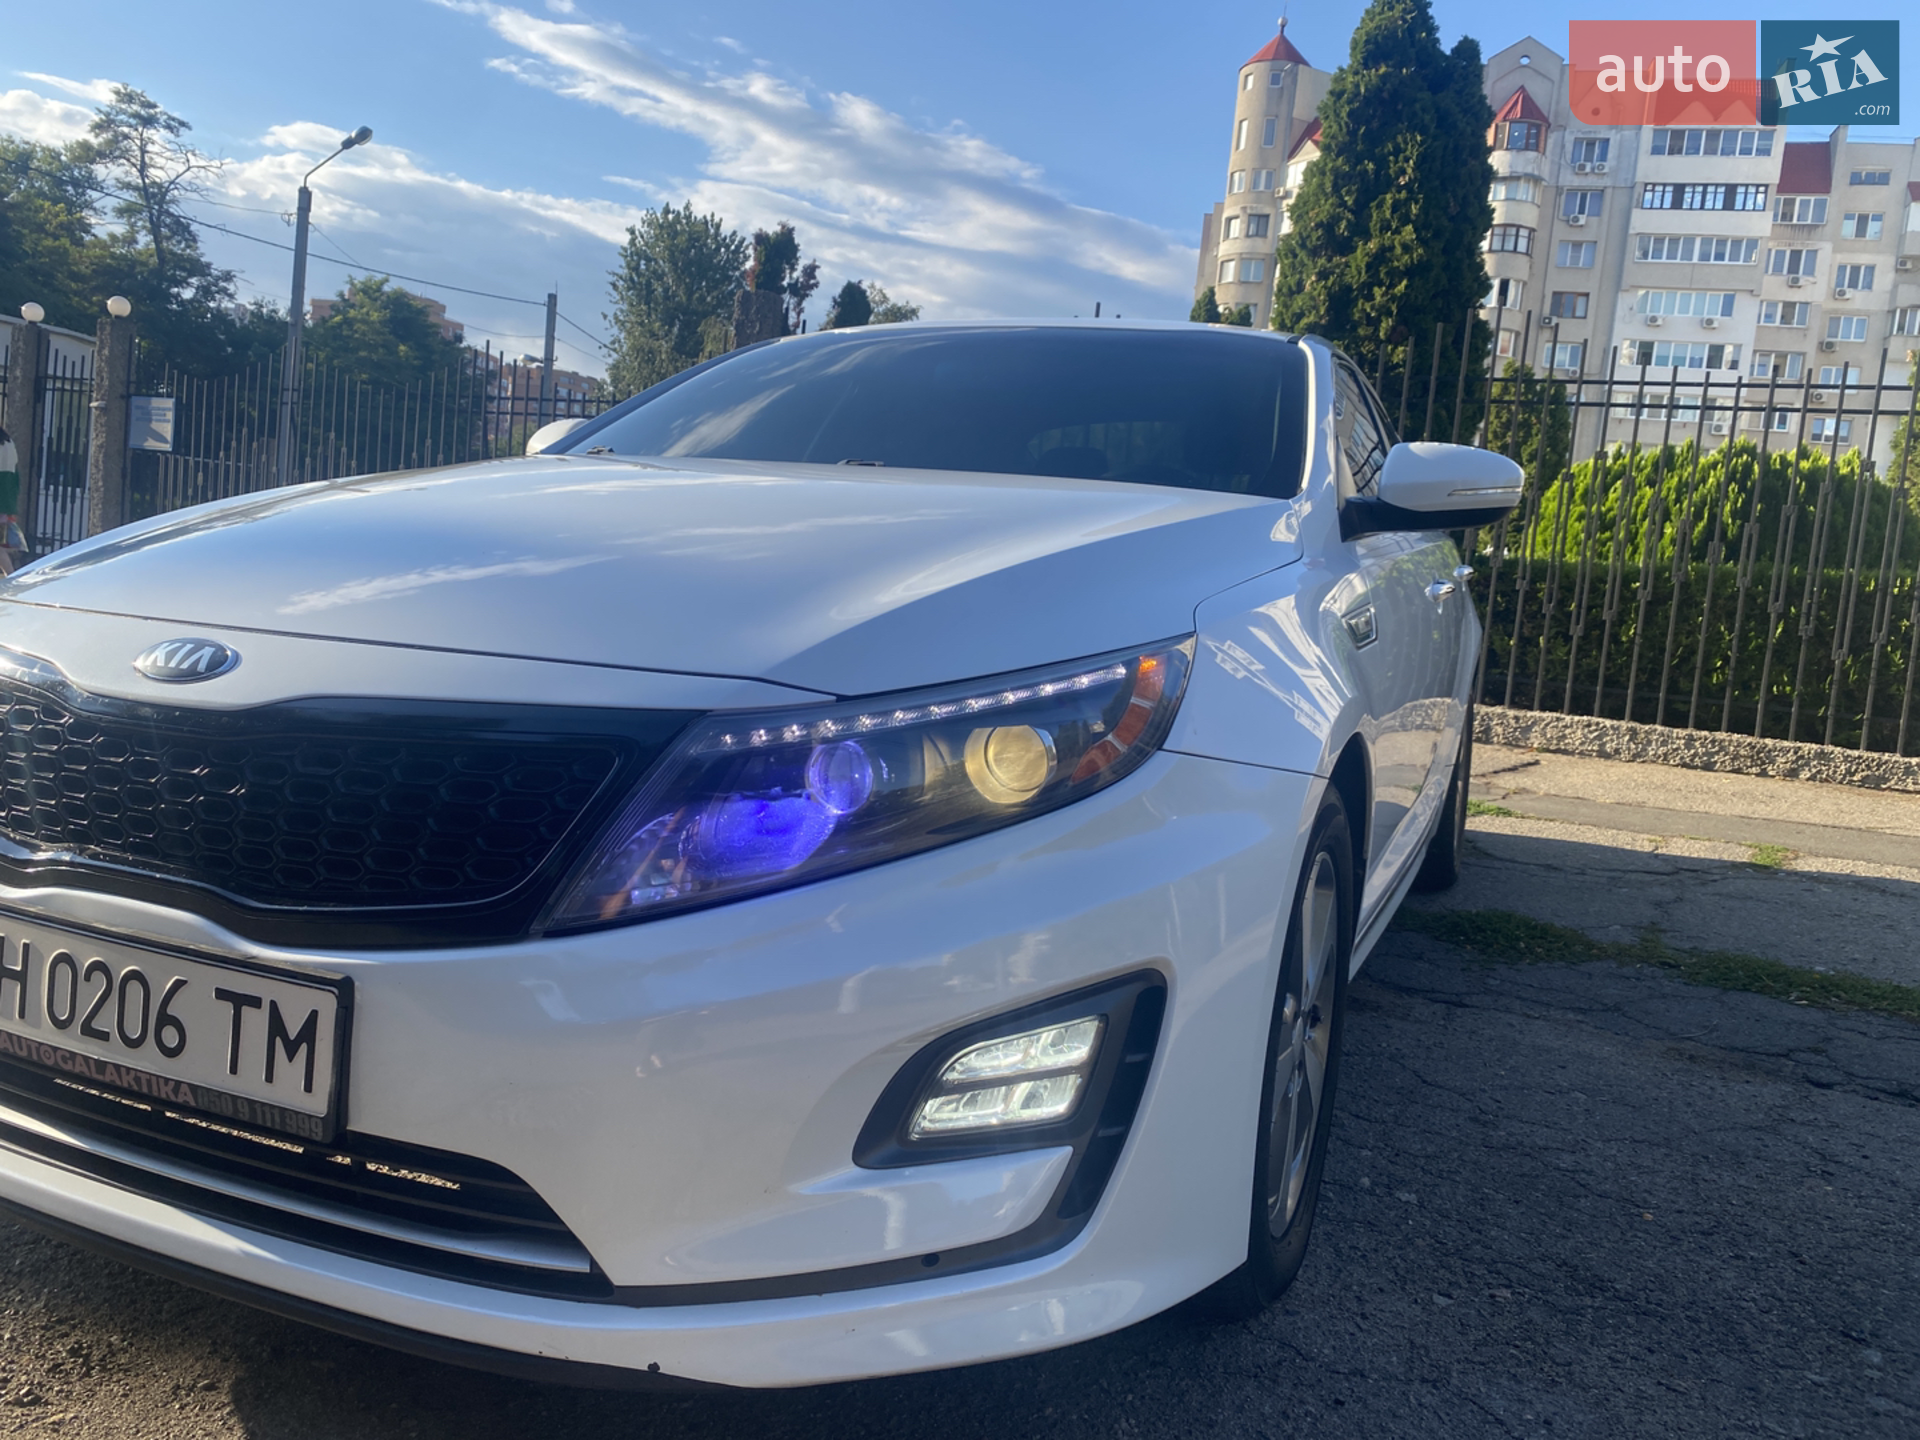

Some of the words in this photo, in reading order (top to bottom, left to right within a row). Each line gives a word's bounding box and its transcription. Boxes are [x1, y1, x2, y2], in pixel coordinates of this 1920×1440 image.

[144, 642, 216, 673] KIA
[46, 949, 189, 1058] 0206
[213, 986, 319, 1094] TM
[0, 1031, 196, 1106] AUTOGALAKTIKA
[284, 1111, 324, 1141] 999
